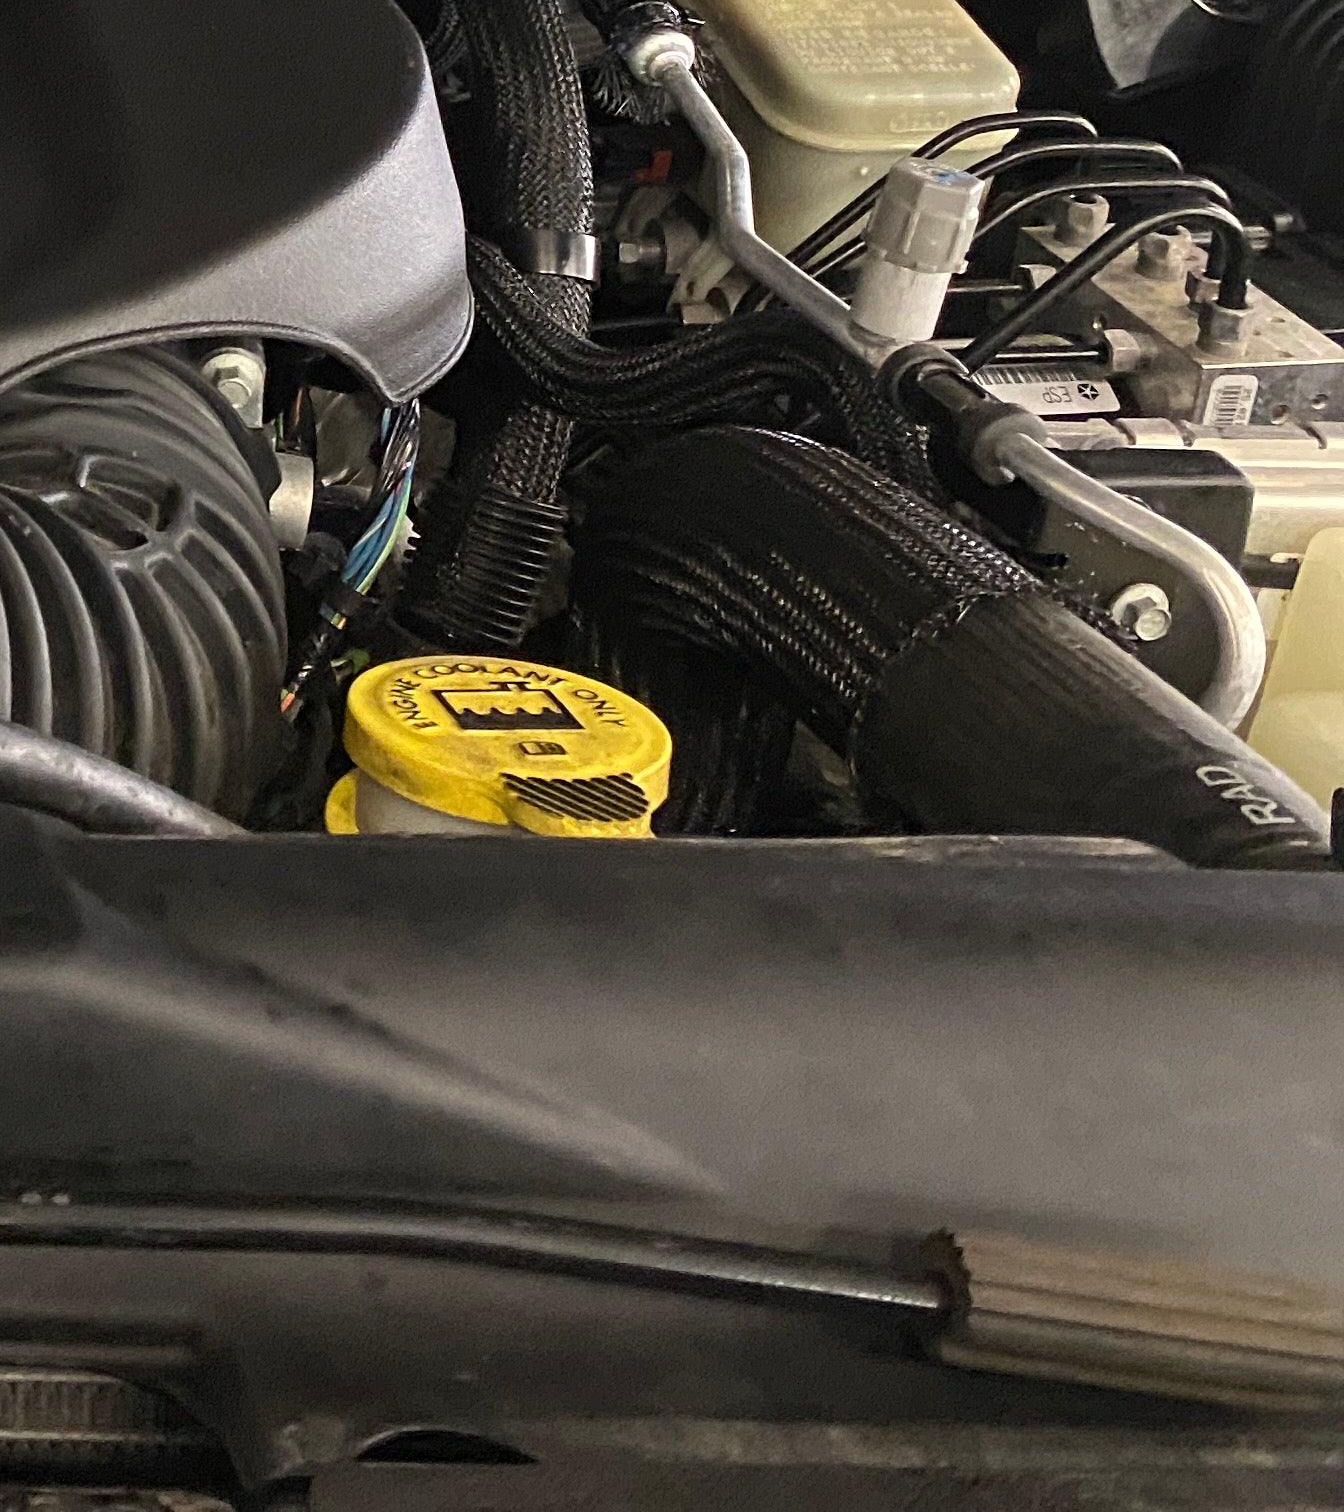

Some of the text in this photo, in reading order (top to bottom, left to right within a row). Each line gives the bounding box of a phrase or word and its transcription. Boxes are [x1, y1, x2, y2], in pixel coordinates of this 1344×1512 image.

[389, 663, 627, 729] ENGINE COOLANT ONLY
[1195, 765, 1296, 825] RAD
